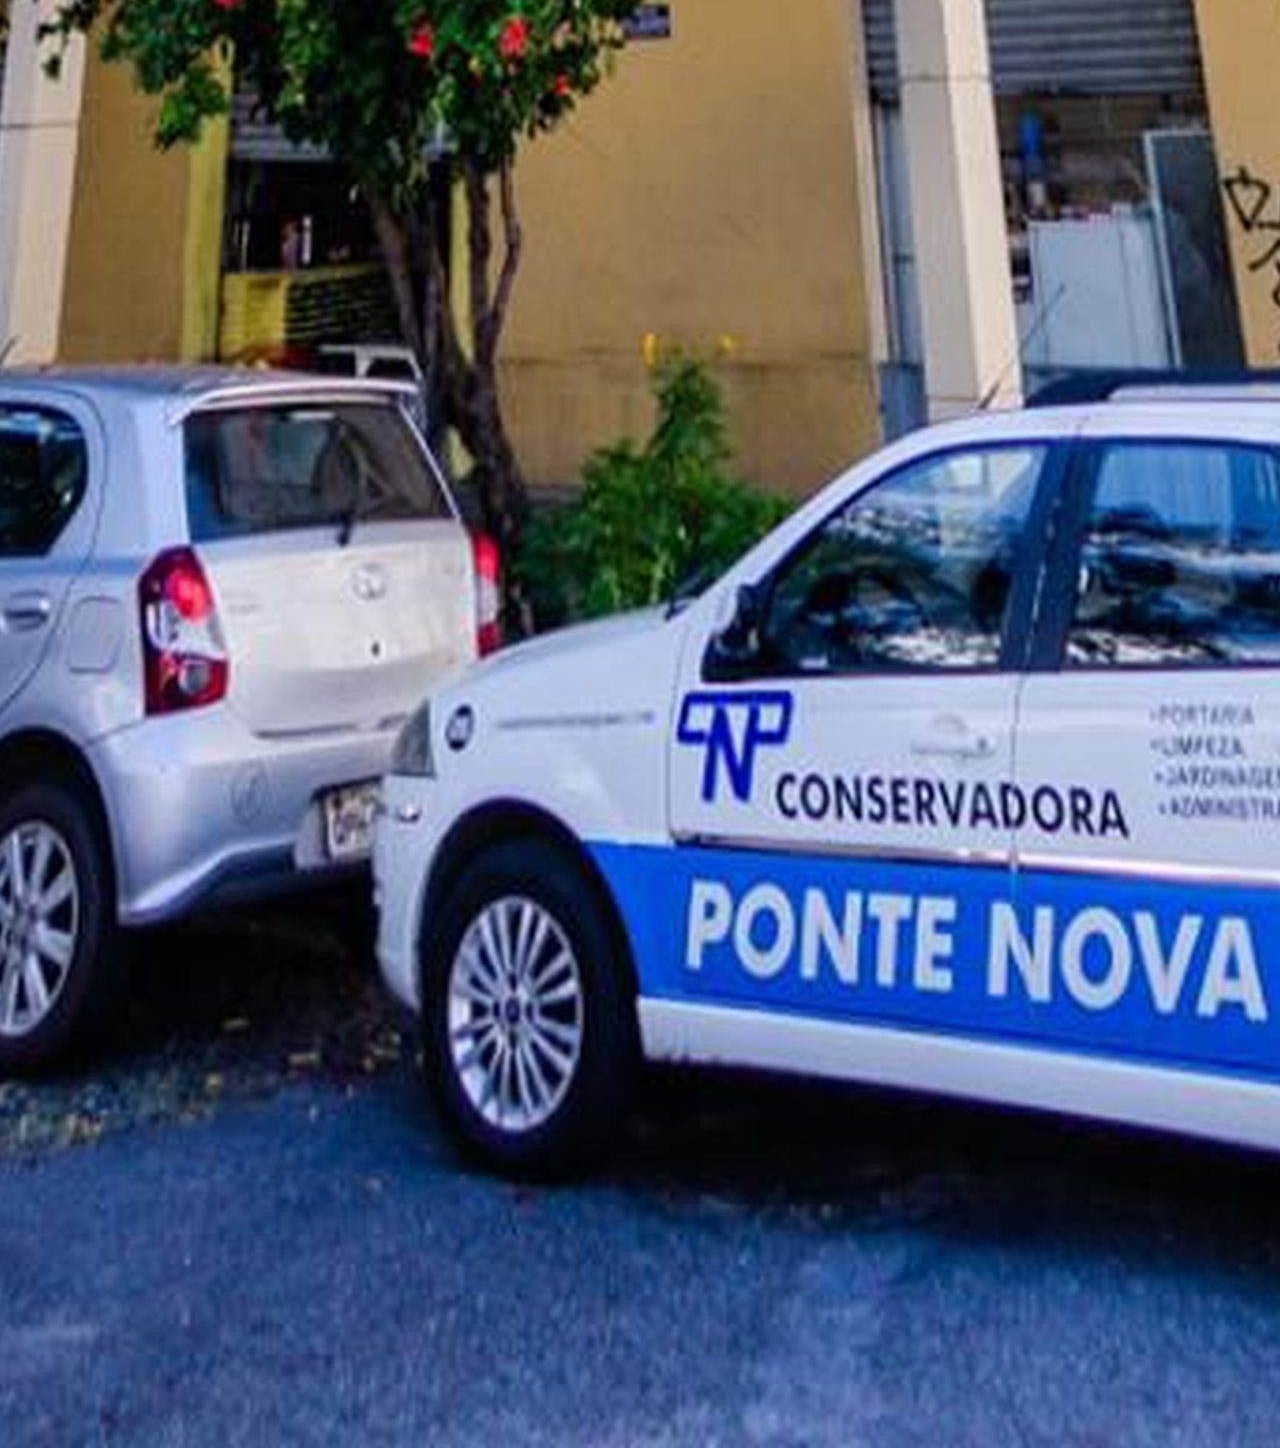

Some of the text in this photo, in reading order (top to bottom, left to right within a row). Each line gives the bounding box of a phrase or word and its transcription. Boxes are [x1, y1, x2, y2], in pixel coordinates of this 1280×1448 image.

[1160, 705, 1255, 728] PORTARIA
[1162, 736, 1244, 756] LIMPEZA
[776, 773, 1129, 838] CONSERVADORA
[685, 878, 1268, 1023] PONTE NOVA
